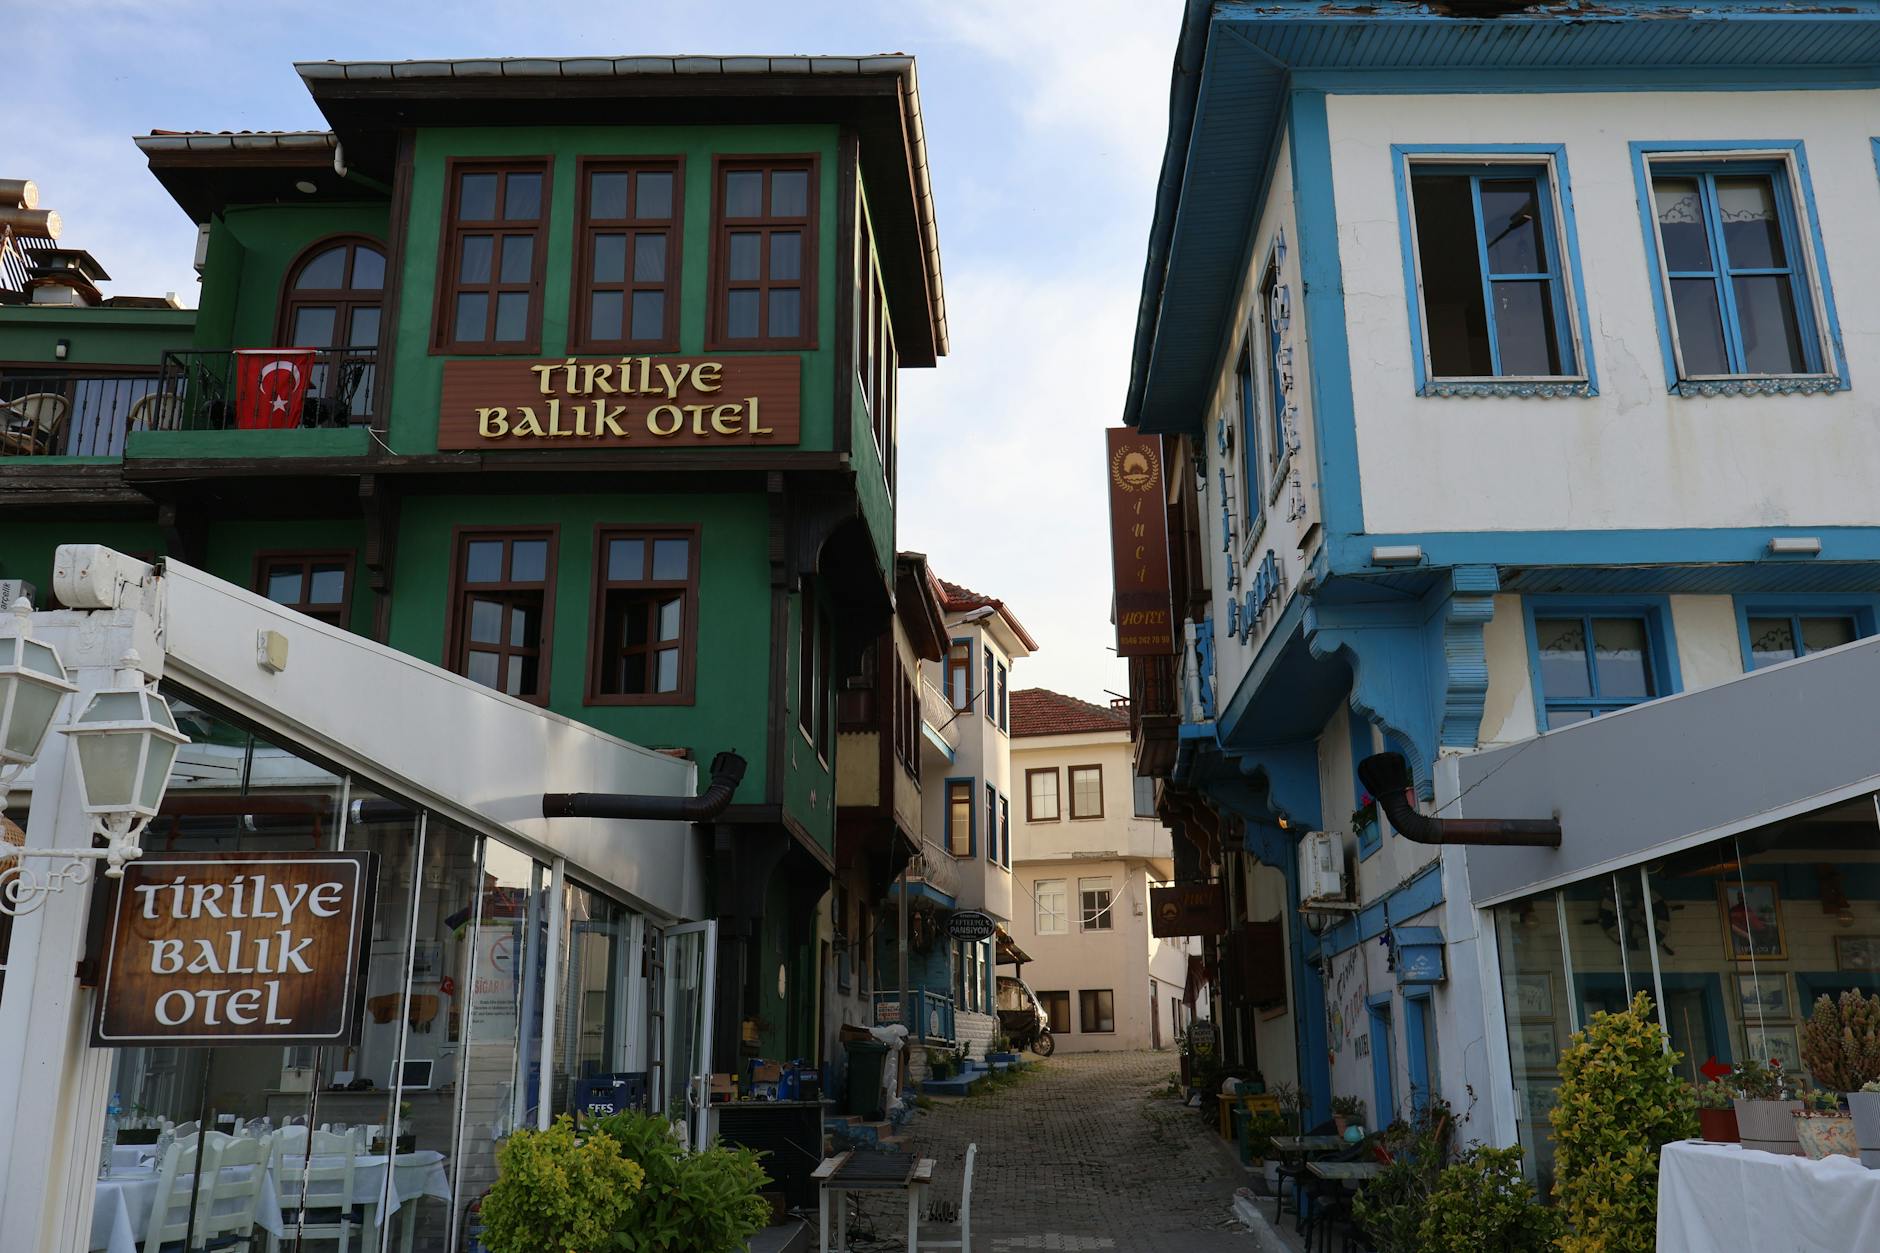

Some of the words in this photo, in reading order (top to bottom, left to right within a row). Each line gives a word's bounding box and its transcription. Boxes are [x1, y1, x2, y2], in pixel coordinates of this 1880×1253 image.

[475, 399, 629, 438] BALIK
[646, 397, 773, 435] OTEL
[1121, 611, 1166, 625] HOTEL
[950, 926, 988, 934] PANSİYON
[149, 930, 314, 974] BALIK
[154, 980, 293, 1026] OTEL
